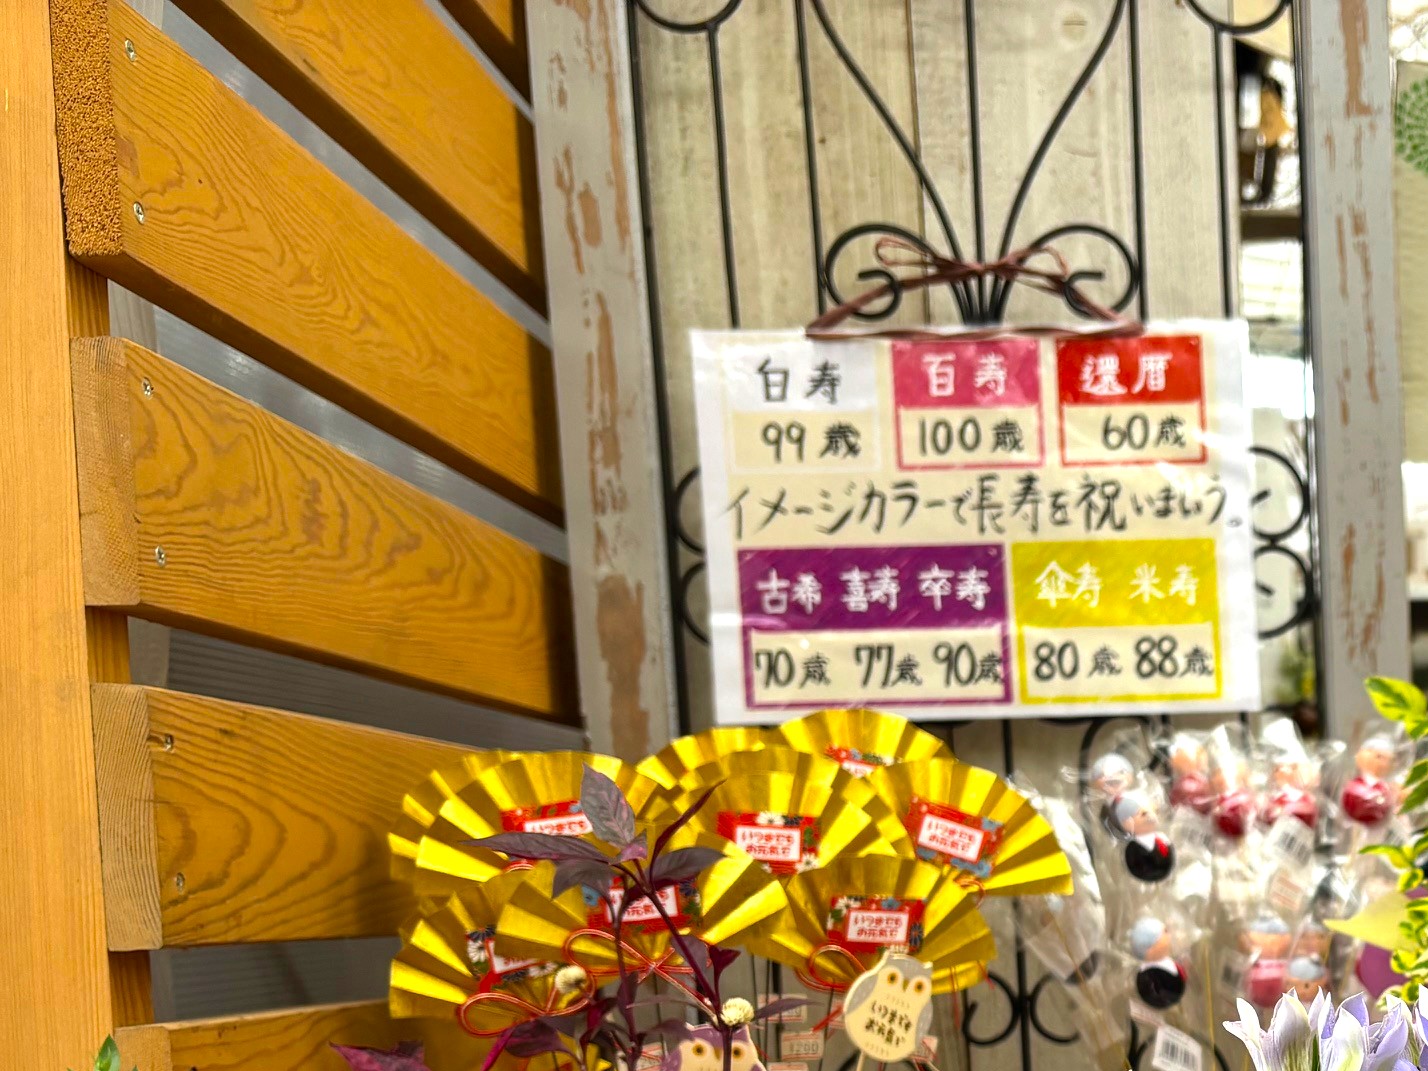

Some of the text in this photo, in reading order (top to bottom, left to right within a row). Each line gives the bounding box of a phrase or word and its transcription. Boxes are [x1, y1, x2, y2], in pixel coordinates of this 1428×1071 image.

[757, 355, 841, 405] 白寿
[921, 351, 1007, 397] 百寿
[1079, 351, 1174, 396] 還暦
[761, 421, 861, 463] 99歳
[918, 415, 1025, 457] 100歳
[1102, 413, 1187, 451] 60歳
[755, 562, 992, 615] 古希 喜寿 卒寿
[1034, 560, 1200, 608] 傘寿 米寿
[755, 640, 1005, 690] 70歳 77歳 90歳
[1033, 634, 1214, 682] 80歳 88歳
